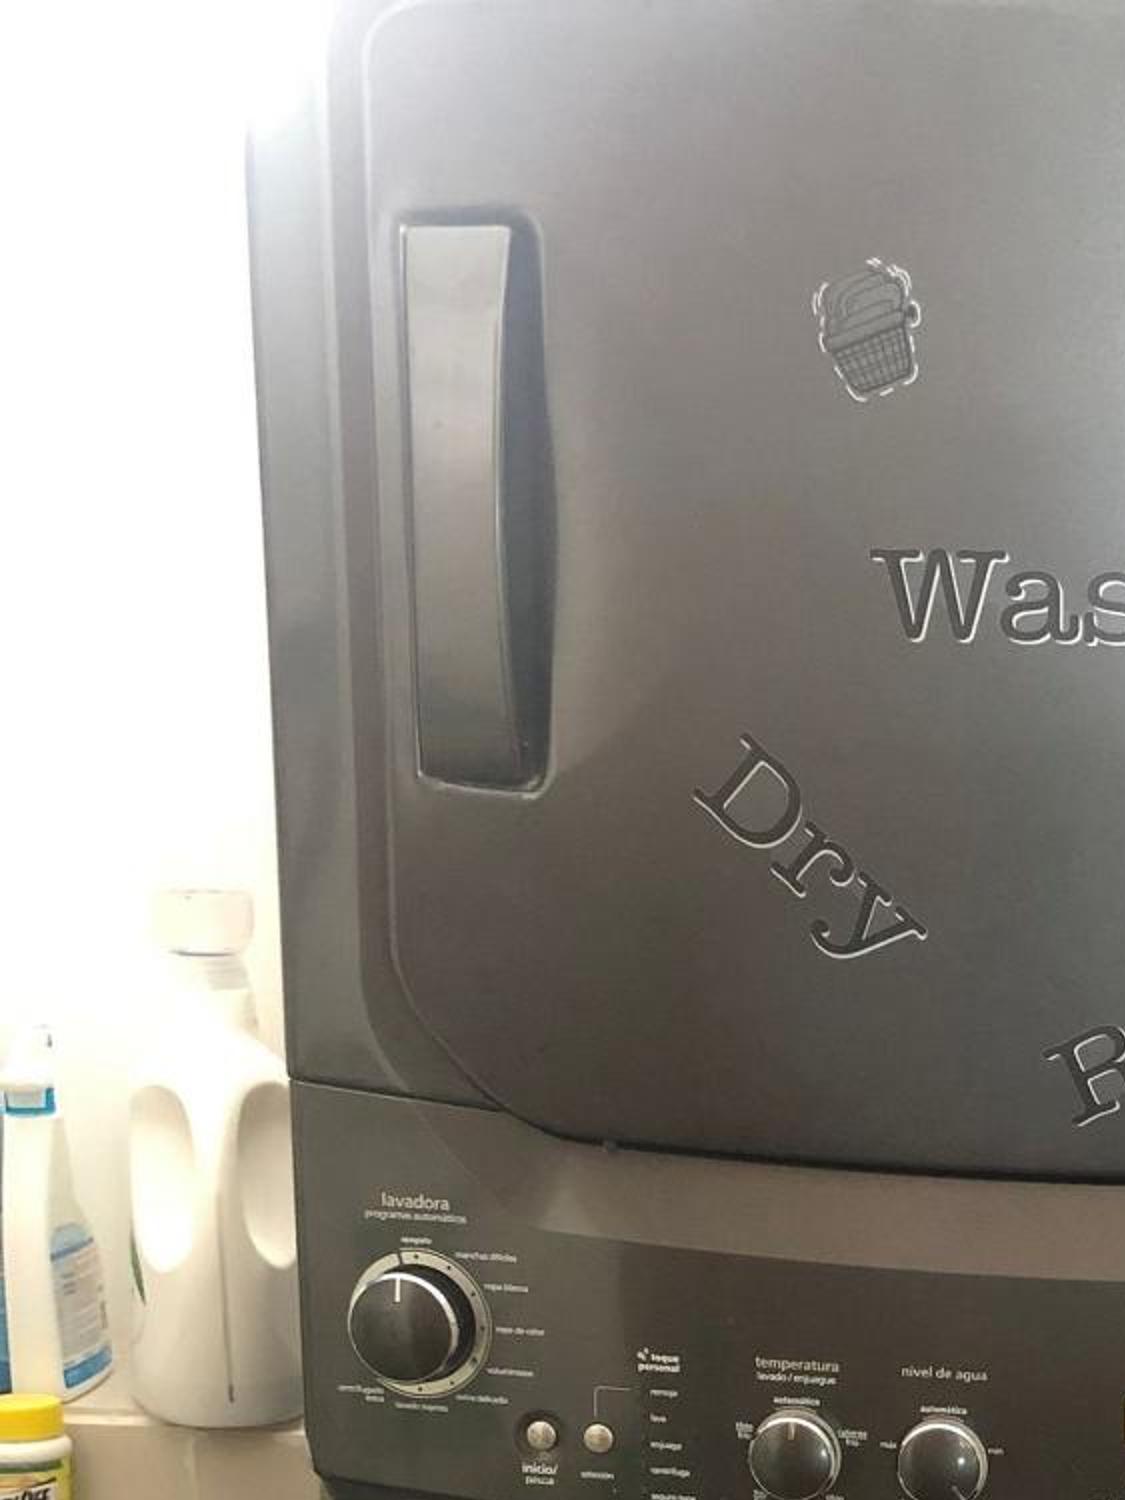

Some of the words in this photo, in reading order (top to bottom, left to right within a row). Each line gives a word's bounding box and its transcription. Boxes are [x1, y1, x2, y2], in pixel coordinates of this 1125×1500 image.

[691, 732, 929, 960] Dry
[381, 1191, 450, 1211] lavadora
[755, 1356, 840, 1375] temperatura
[901, 1366, 934, 1379] nivel
[935, 1367, 952, 1380] de
[955, 1370, 989, 1384] agua
